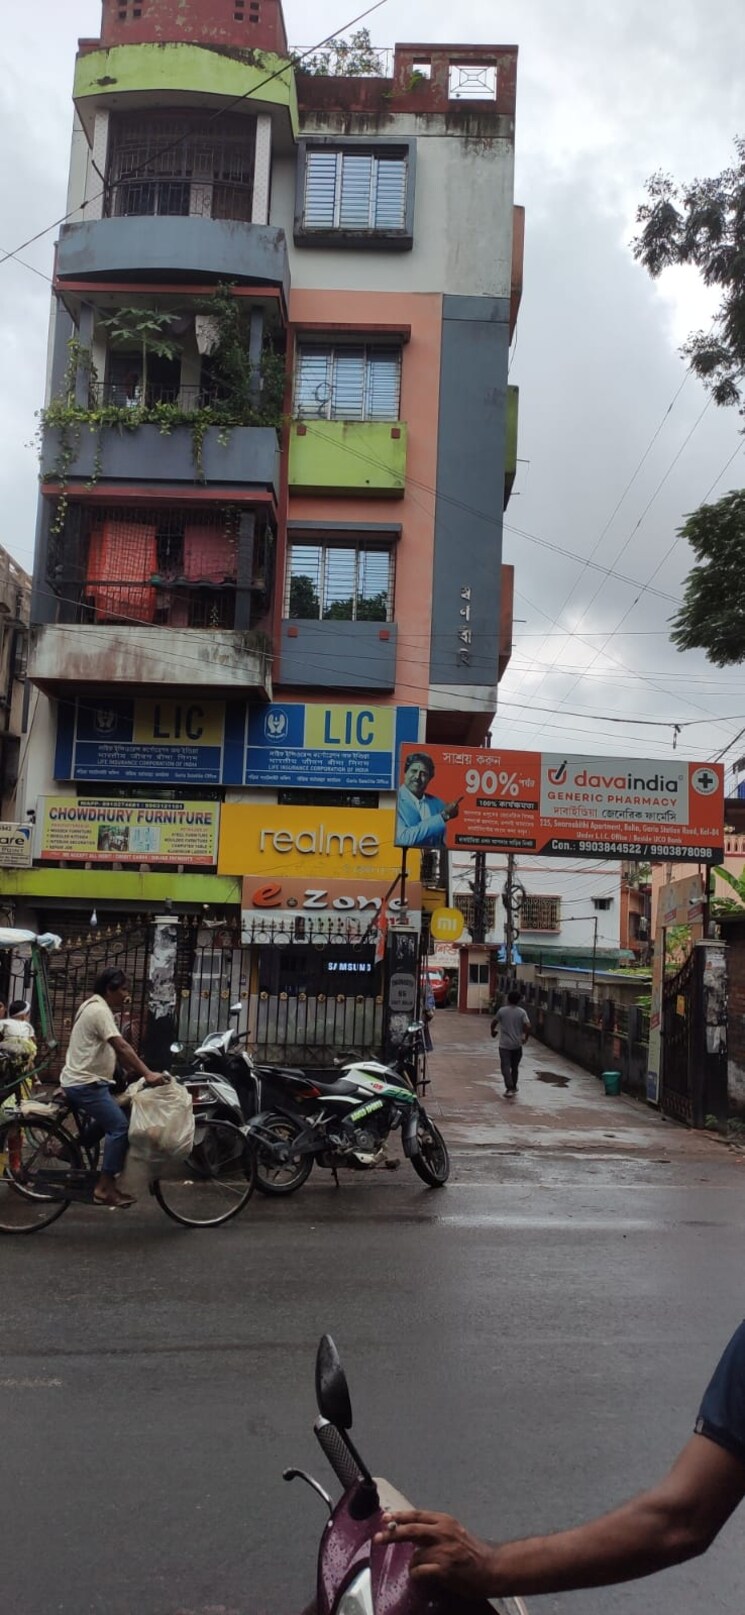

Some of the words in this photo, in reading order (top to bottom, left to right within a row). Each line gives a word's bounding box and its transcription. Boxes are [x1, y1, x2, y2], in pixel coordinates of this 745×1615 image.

[153, 704, 204, 740] LIC
[323, 710, 374, 745] LIC
[465, 769, 519, 796] 90%
[574, 769, 678, 793] davaindia
[547, 791, 603, 803] GENERIC
[607, 794, 678, 808] PHARMACY
[49, 807, 132, 823] CHOWDHURY
[137, 810, 212, 825] FURNITURE
[602, 807, 643, 819] জেনেরিক
[260, 824, 379, 856] realme
[579, 841, 642, 855] 9903844522
[650, 845, 713, 859] 9903878098
